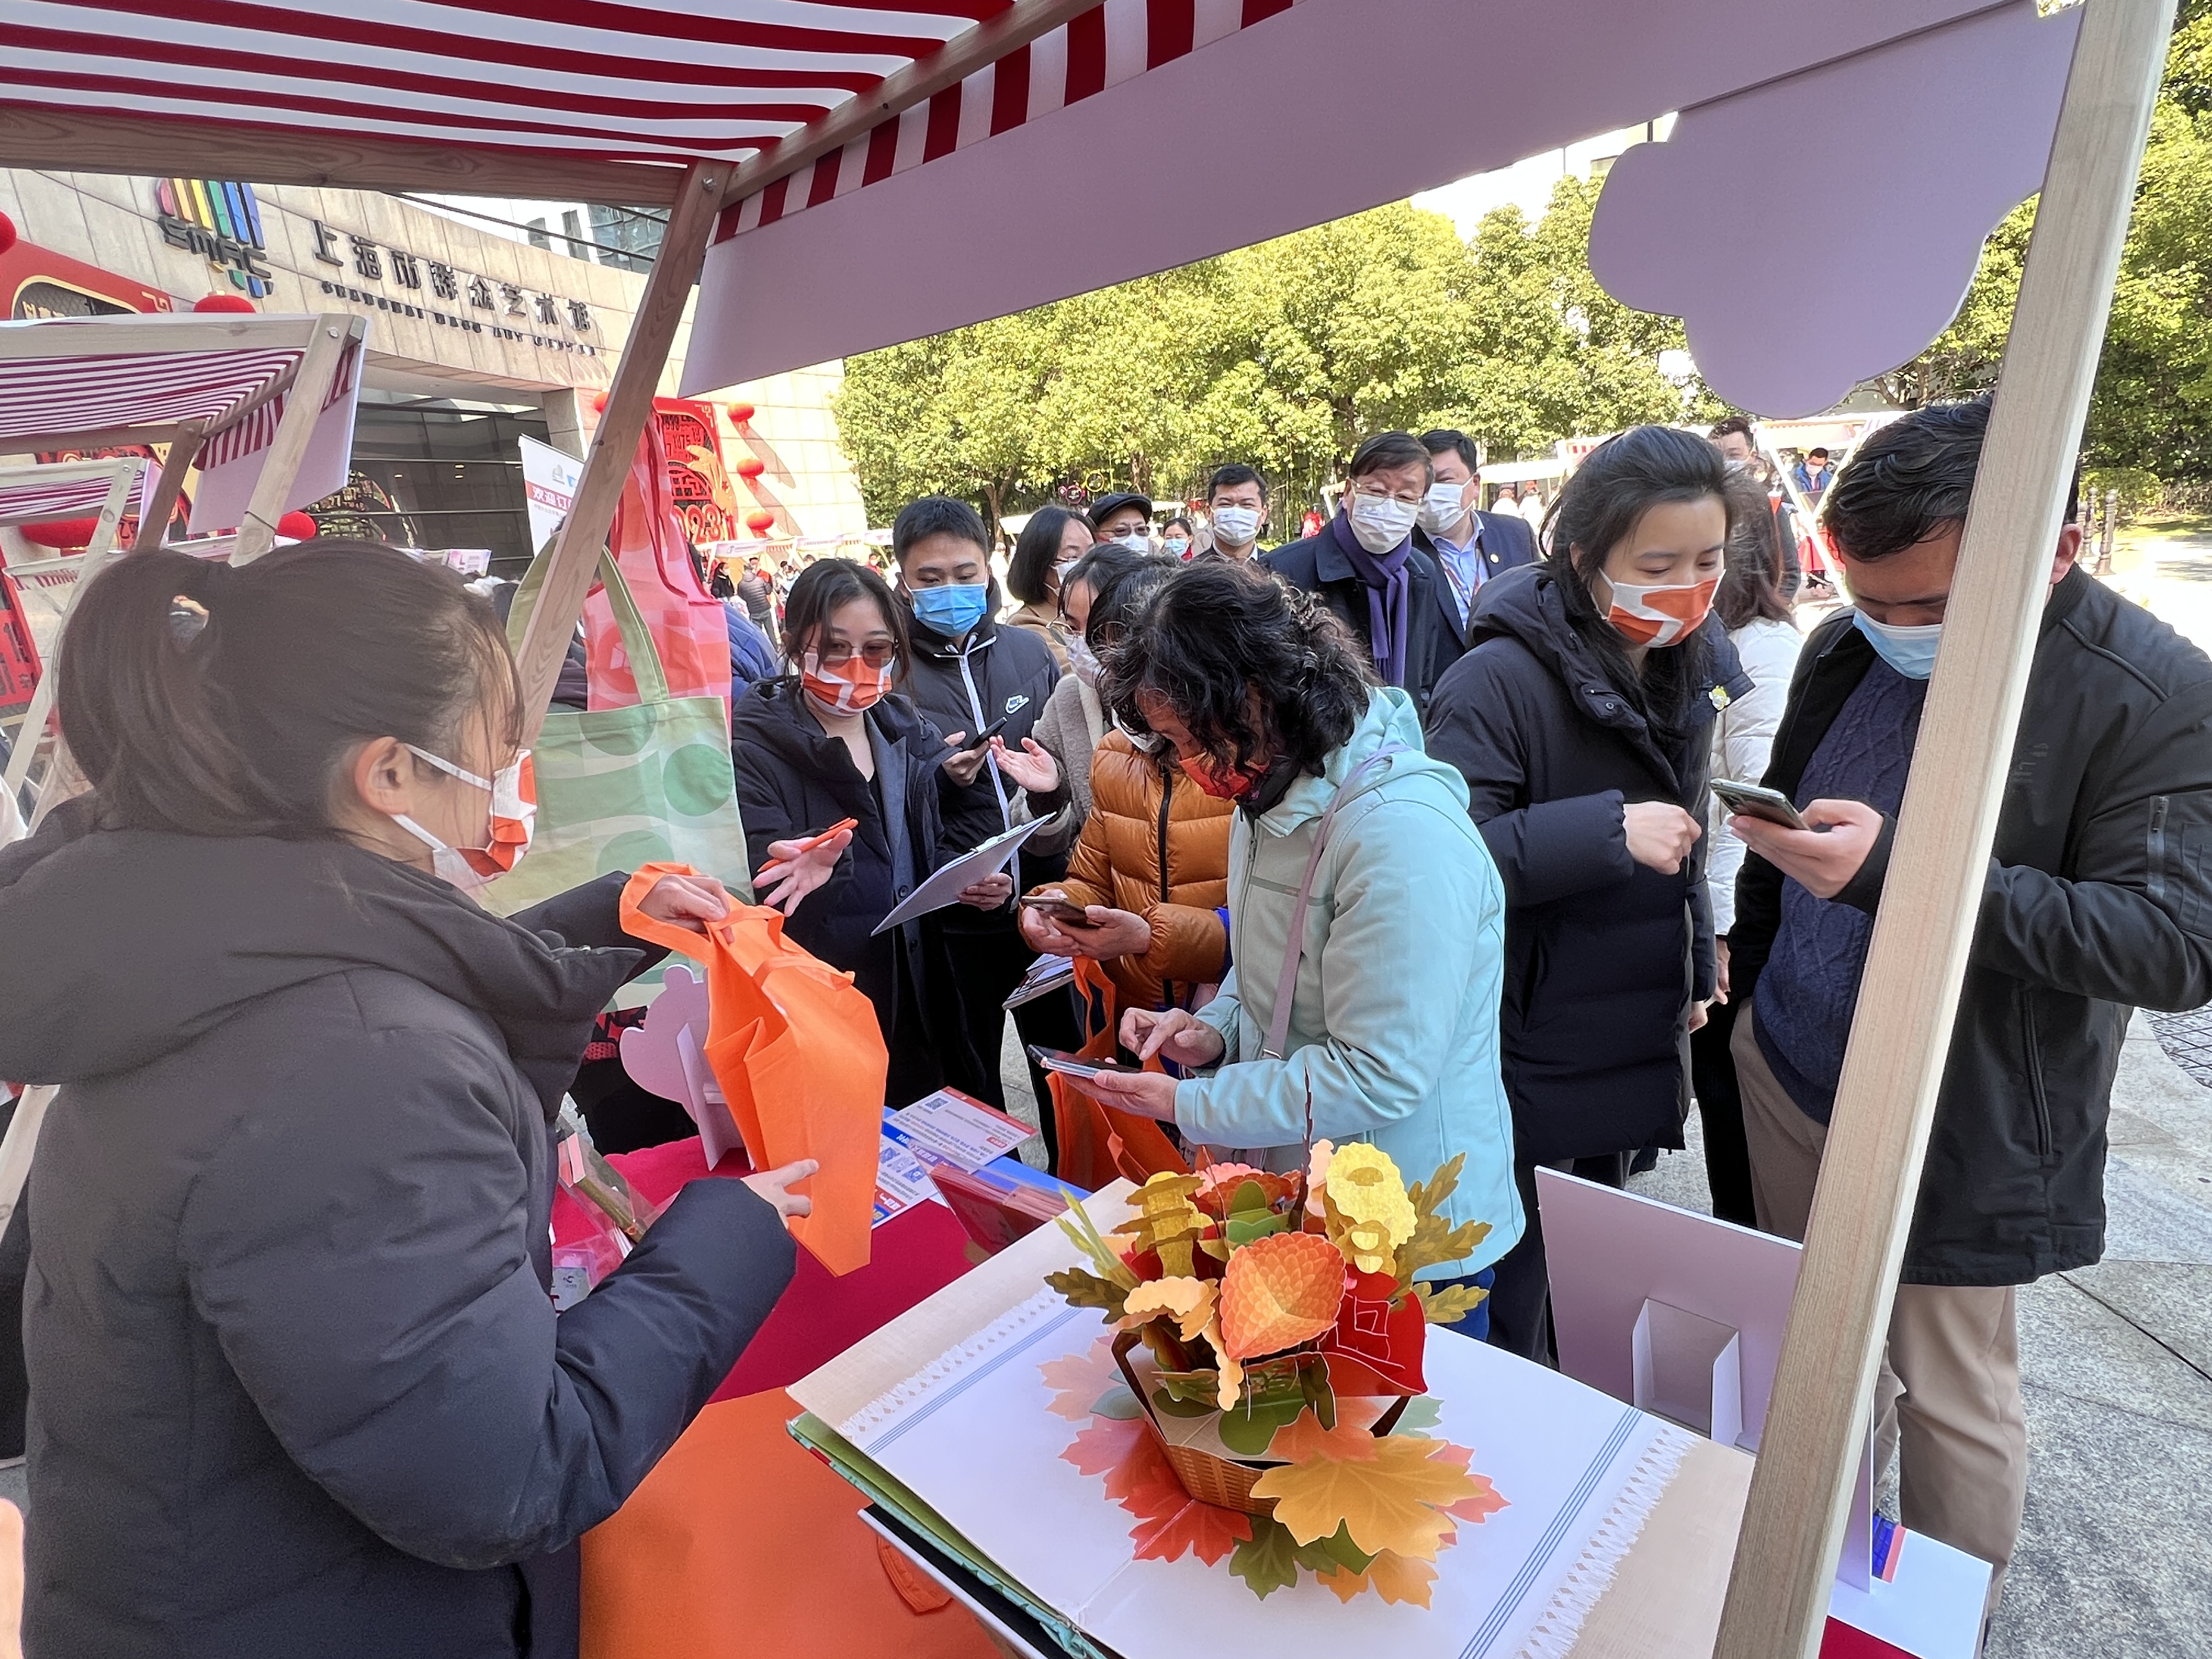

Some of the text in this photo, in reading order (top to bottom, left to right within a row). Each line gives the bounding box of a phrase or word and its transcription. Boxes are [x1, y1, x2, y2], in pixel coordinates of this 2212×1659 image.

[311, 218, 591, 332] 上海市群众艺术馆
